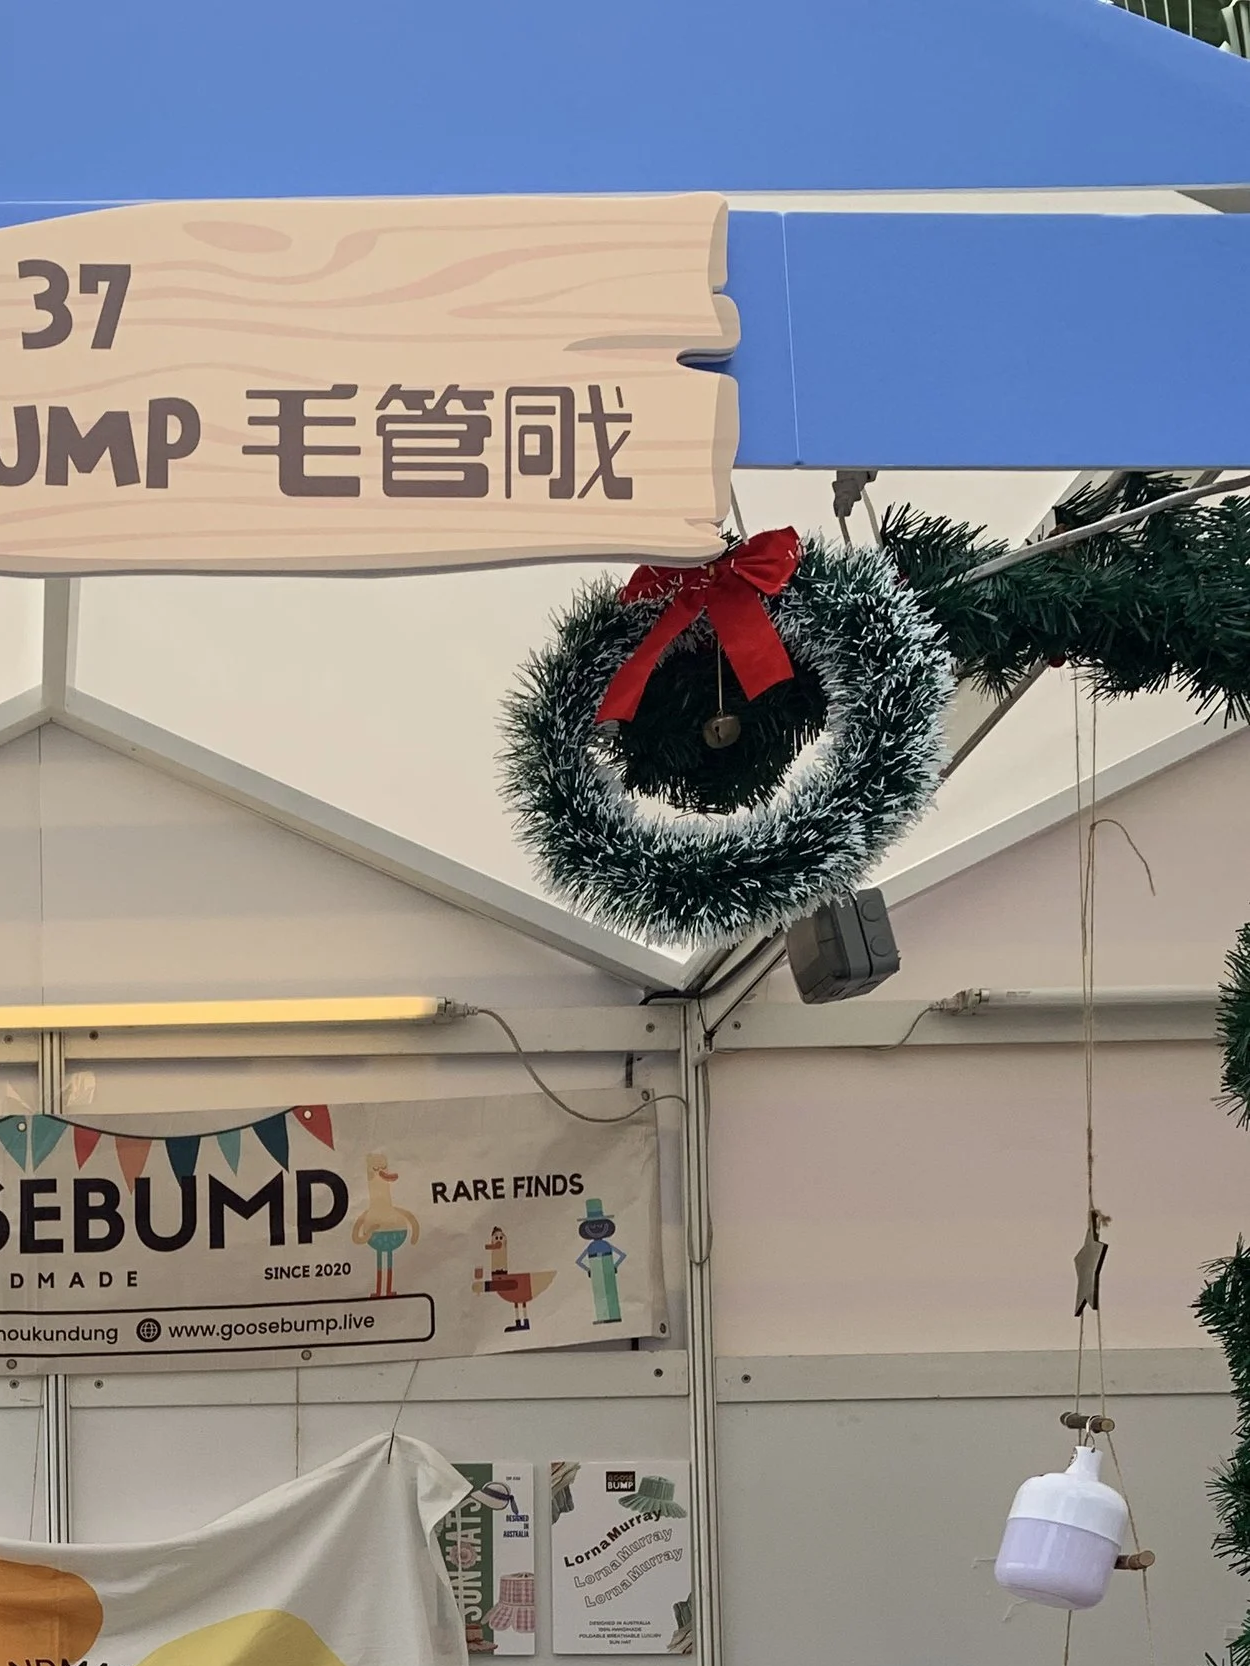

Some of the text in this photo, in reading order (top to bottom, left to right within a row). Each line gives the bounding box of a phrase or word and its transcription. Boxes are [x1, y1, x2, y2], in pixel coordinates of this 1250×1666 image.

[19, 259, 131, 351] 37
[241, 382, 634, 499] 毛管戙
[431, 1173, 585, 1204] RARE FINDS
[264, 1262, 351, 1281] SINCE 2020
[167, 1313, 376, 1341] www.goosebump.live
[607, 1482, 634, 1490] BUMP
[505, 1514, 529, 1522] DESIGNED
